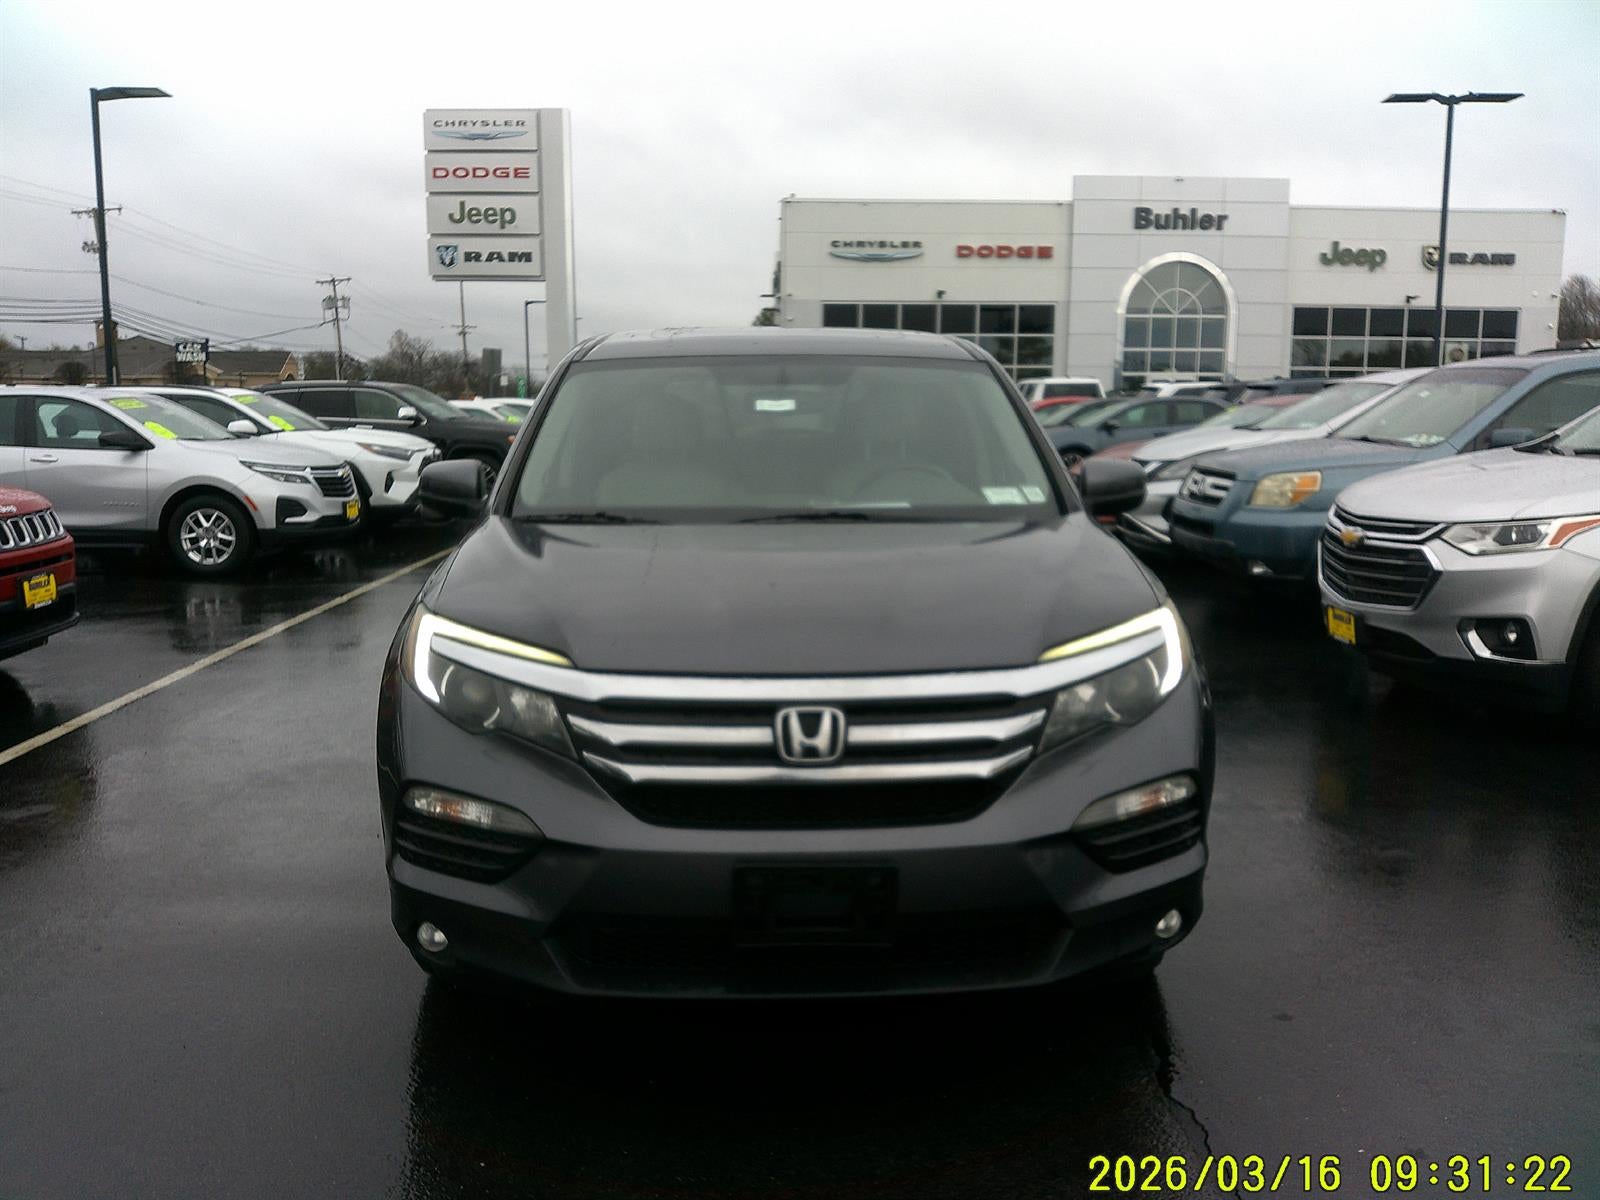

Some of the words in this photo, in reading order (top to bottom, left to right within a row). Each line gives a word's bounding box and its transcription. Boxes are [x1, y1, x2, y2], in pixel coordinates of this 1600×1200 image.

[432, 167, 531, 179] DODGE
[448, 200, 517, 229] Jeep
[1134, 207, 1229, 230] Buhler
[830, 240, 923, 249] CHRYSLER
[463, 251, 533, 263] RAM
[956, 245, 1054, 259] DODGE
[1319, 241, 1387, 272] Jeep
[1449, 252, 1516, 265] RAM
